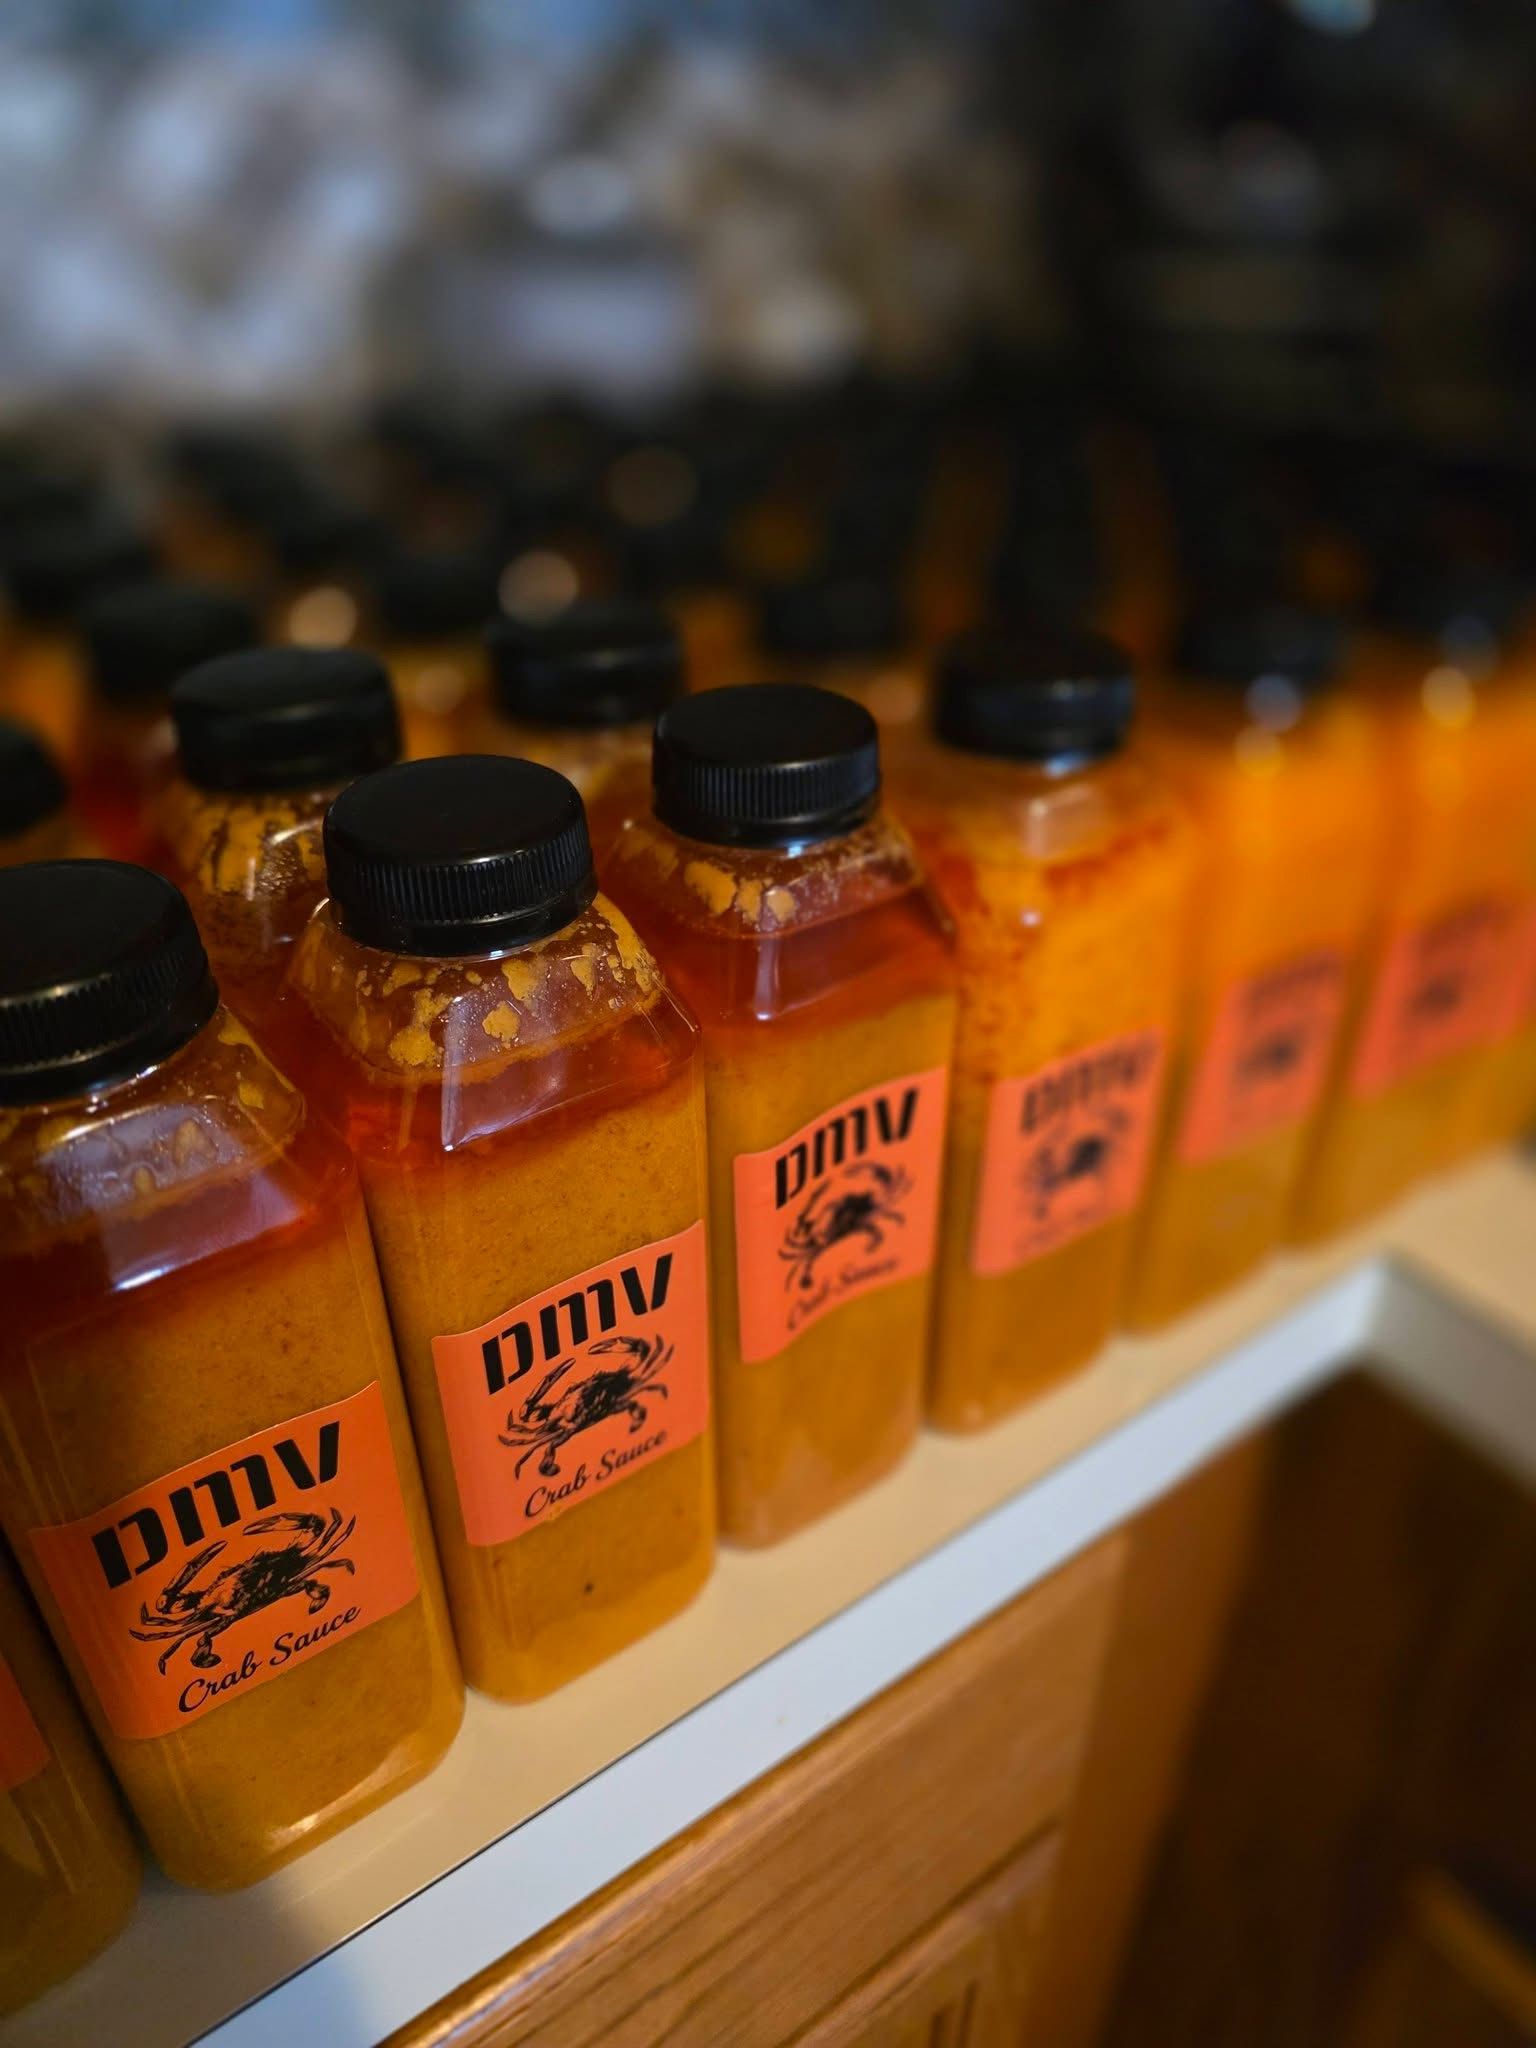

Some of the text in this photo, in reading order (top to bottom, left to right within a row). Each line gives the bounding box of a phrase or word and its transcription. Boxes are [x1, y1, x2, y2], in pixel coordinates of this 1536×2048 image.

[775, 1087, 919, 1210] DMV
[481, 1252, 673, 1395] DMV
[91, 1421, 340, 1589] DMV
[525, 1430, 668, 1518] Crab Sauce
[178, 1606, 361, 1713] Crab Sauce
